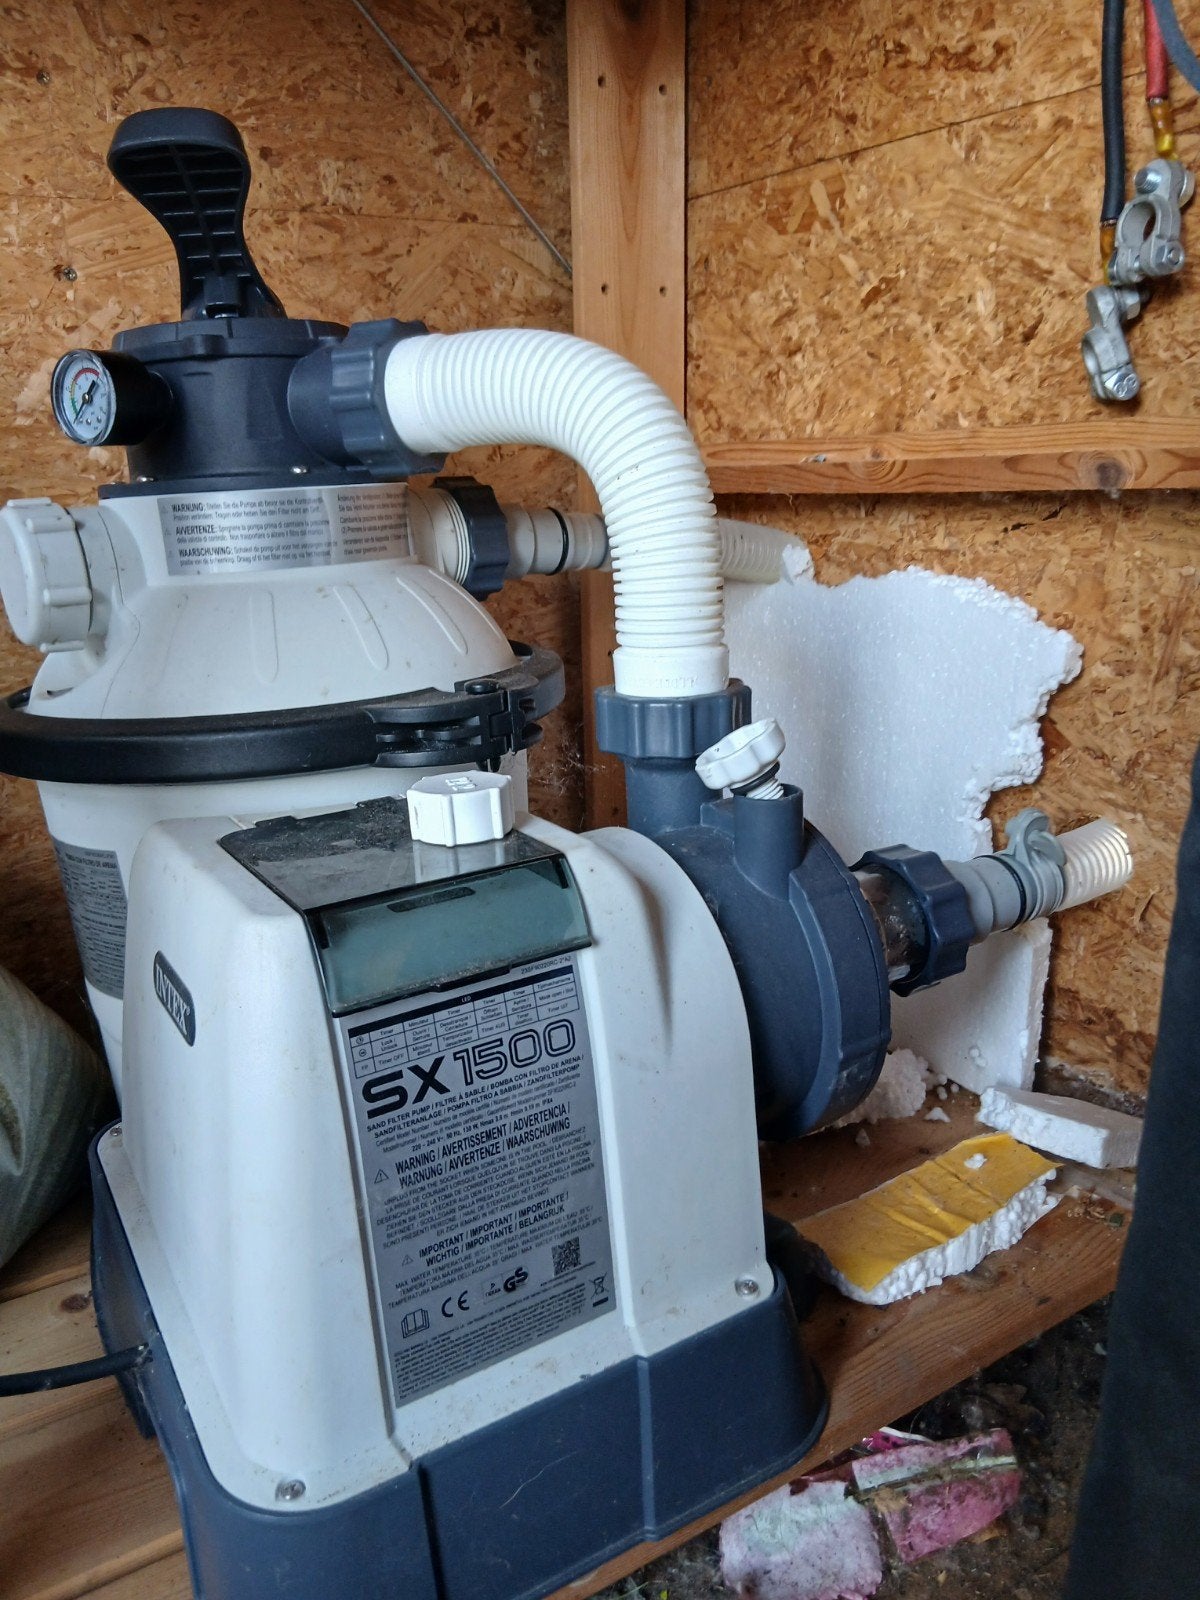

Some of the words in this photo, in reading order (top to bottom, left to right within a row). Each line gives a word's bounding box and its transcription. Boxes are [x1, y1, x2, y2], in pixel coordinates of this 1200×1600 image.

[360, 1054, 451, 1121] SX
[452, 1014, 577, 1091] 1500
[366, 1119, 387, 1131] SAND
[386, 1111, 410, 1124] FILTER
[410, 1104, 431, 1116] PUMP
[434, 1096, 457, 1108] FILTRE
[463, 1086, 485, 1098] SABLE
[490, 1077, 513, 1089] BOMBA
[513, 1072, 528, 1081] CON
[528, 1065, 550, 1076] FILTRO
[551, 1061, 559, 1070] DE
[559, 1054, 581, 1066] ARENA
[373, 1110, 441, 1137] SANDFILTERANLAGE
[446, 1100, 470, 1112] POMPA
[470, 1092, 493, 1104] FILTRO
[499, 1082, 523, 1095] SABBIA
[526, 1063, 580, 1085] ZANDFILTERPOMP
[395, 1150, 436, 1174] WARNING
[440, 1124, 508, 1159] AVERTISSEMENT
[512, 1103, 567, 1133] ADVERTENCIA
[397, 1162, 443, 1189] WARNUNG
[447, 1140, 501, 1172] AVVERTENZE
[505, 1116, 570, 1151] WAARSCHUWING
[439, 1171, 462, 1184] SOCKET
[462, 1165, 479, 1175] WHEN
[418, 1233, 464, 1257] IMPORTANT
[469, 1213, 513, 1237] IMPORTANT
[517, 1193, 565, 1218] IMPORTANTE
[425, 1246, 460, 1266] WICHTIG
[464, 1225, 513, 1250] IMPORTANTE
[518, 1204, 565, 1229] BELANGRIJK
